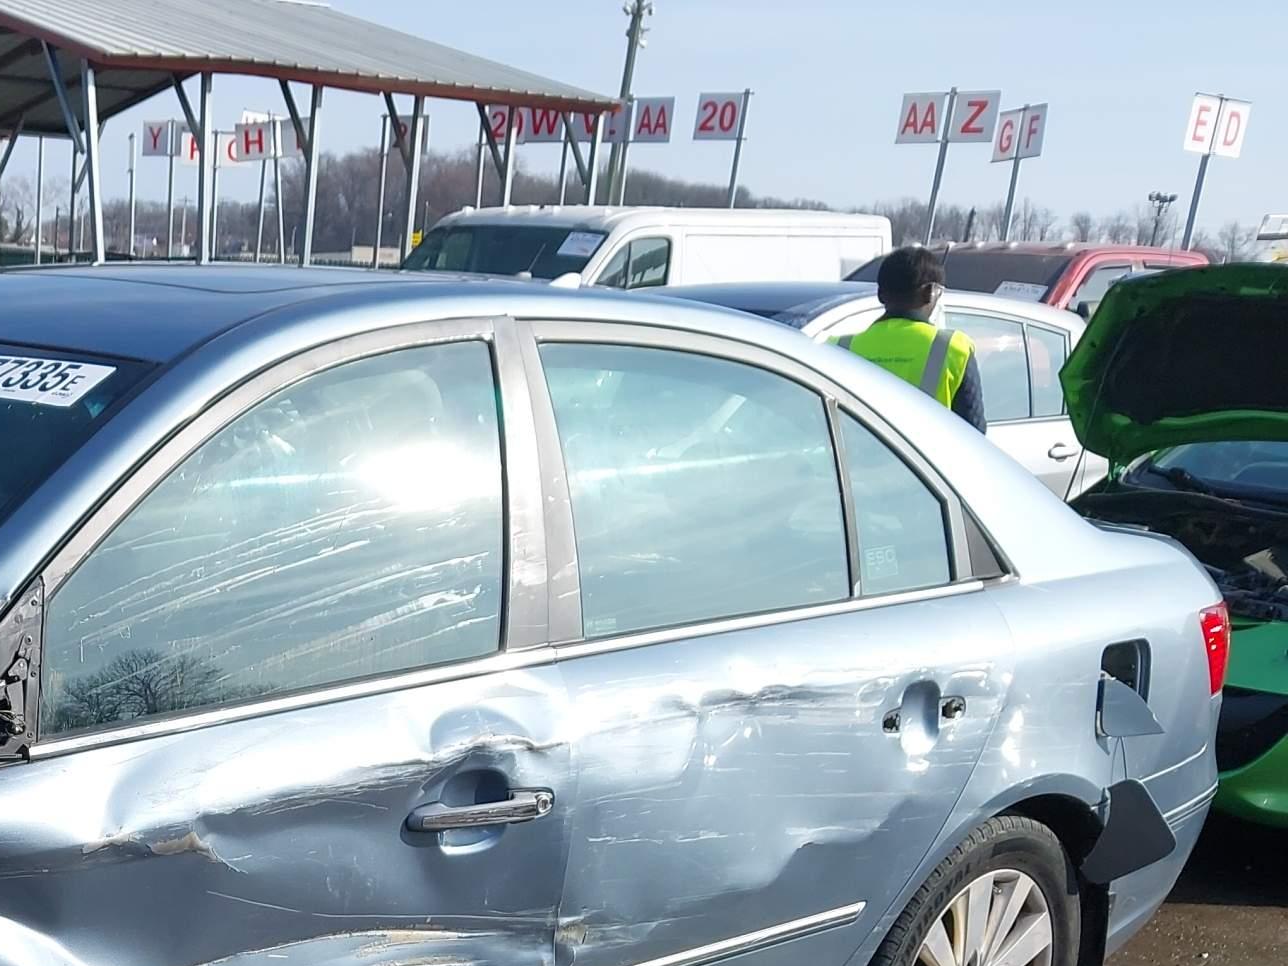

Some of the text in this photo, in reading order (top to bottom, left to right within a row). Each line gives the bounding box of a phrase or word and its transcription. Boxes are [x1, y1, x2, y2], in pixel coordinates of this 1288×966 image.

[530, 107, 560, 136] W
[637, 105, 668, 135] AA
[698, 100, 737, 132] 20
[901, 101, 936, 135] AA
[960, 100, 988, 134] Z
[1026, 114, 1041, 149] F
[1191, 105, 1212, 142] E
[1222, 111, 1241, 146] D
[148, 126, 162, 149] Y
[244, 128, 263, 155] H
[999, 119, 1014, 153] G
